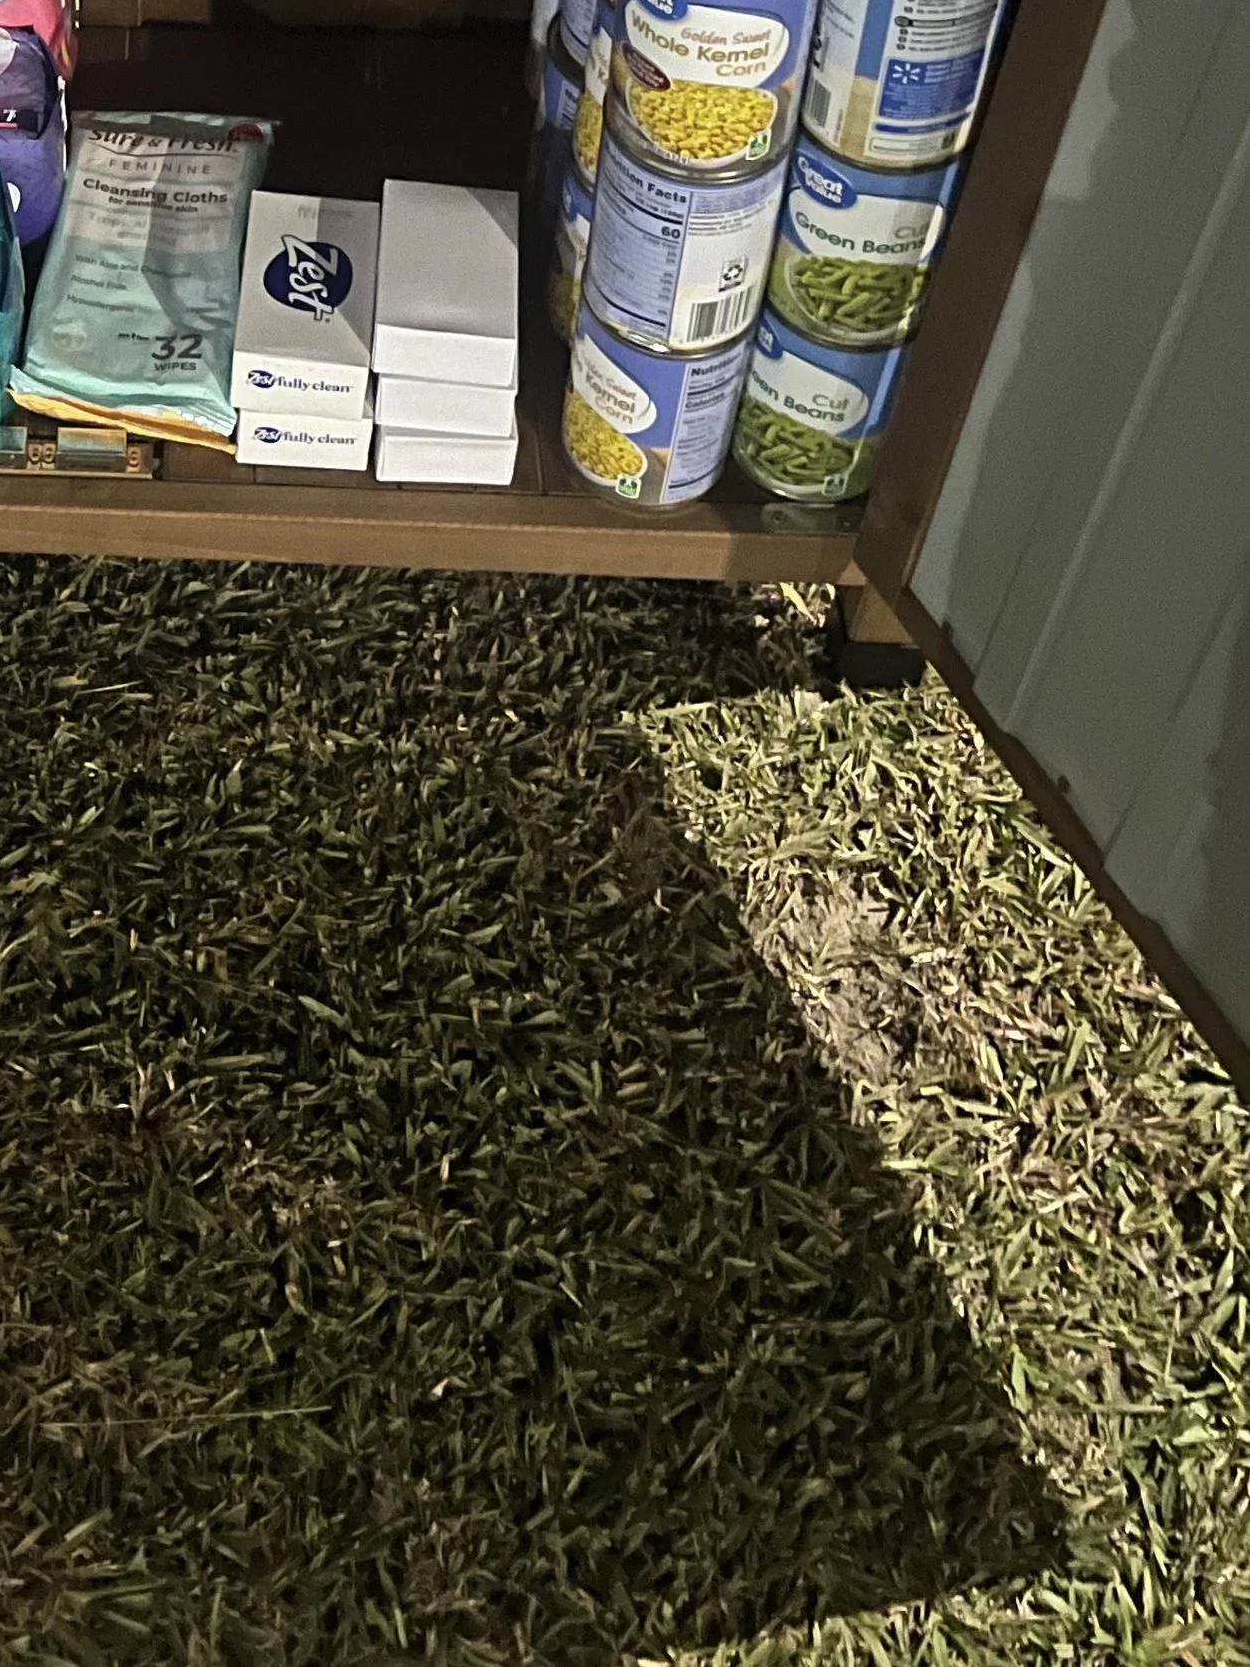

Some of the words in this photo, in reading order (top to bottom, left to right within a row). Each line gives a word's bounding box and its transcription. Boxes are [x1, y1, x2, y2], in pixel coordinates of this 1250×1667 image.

[630, 9, 689, 57] Whole
[697, 43, 771, 64] Kernel
[715, 61, 767, 78] Corn
[107, 159, 212, 175] FEMININE
[797, 155, 844, 196] Great
[82, 177, 167, 203] Cleansing
[172, 189, 228, 205] Cloths
[647, 182, 687, 205] Facts
[107, 195, 124, 206] for
[174, 204, 198, 214] skin
[660, 225, 681, 239] 60
[795, 211, 856, 251] Green
[862, 238, 926, 256] Beans
[279, 233, 341, 322] Zest
[150, 333, 203, 362] 32
[153, 361, 197, 372] WIPES
[277, 375, 310, 392] fully
[311, 380, 351, 393] clean
[593, 395, 634, 426] Corn
[783, 395, 847, 424] Beans
[812, 392, 849, 412] Cut
[283, 430, 316, 445] fully
[317, 433, 356, 446] clean
